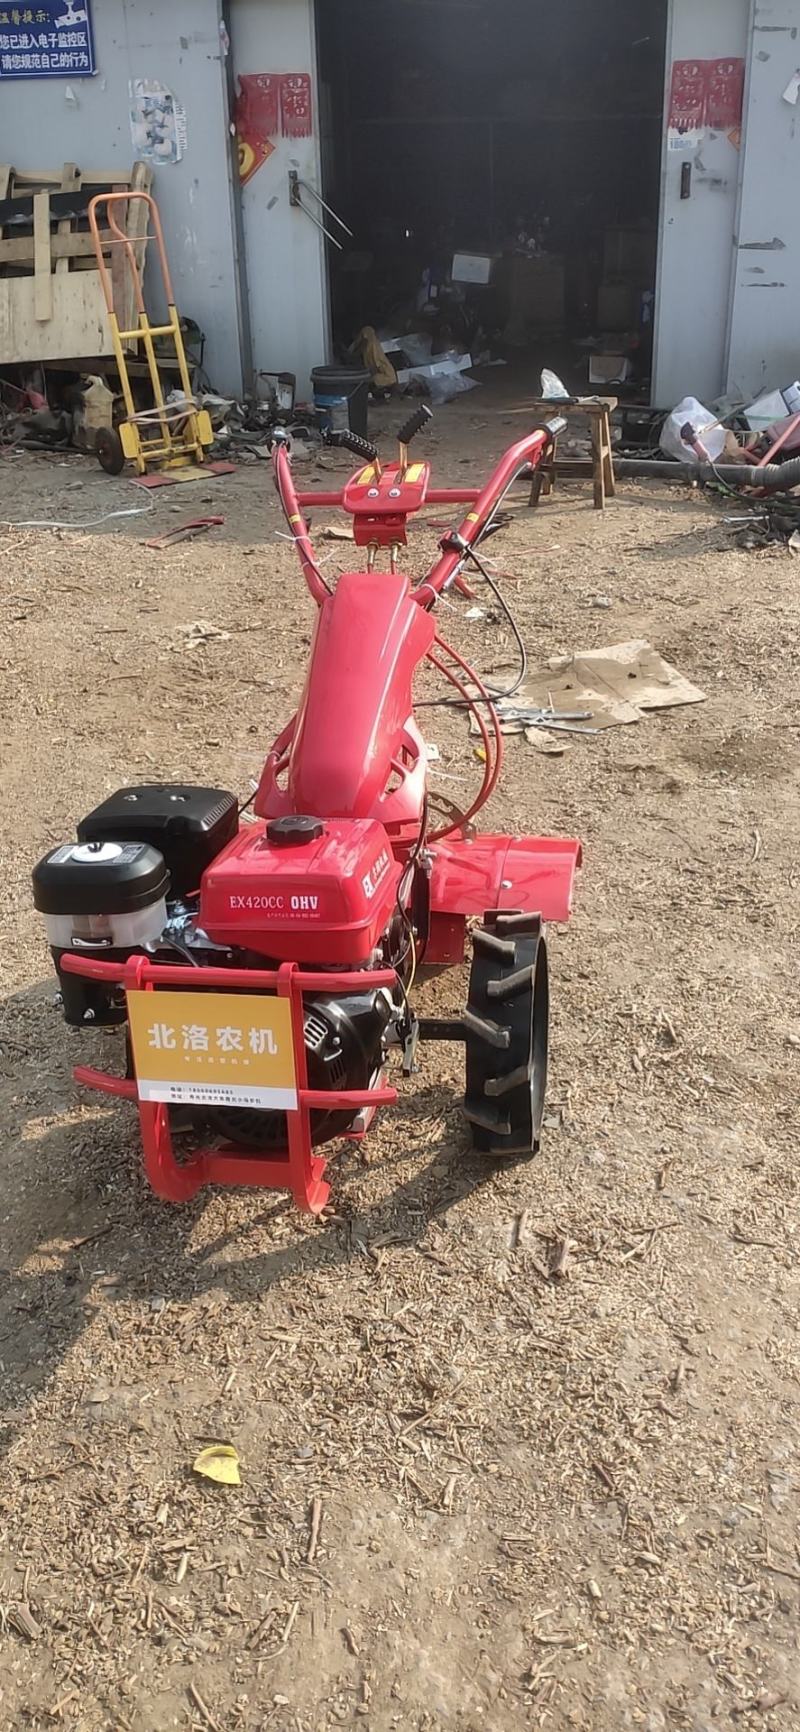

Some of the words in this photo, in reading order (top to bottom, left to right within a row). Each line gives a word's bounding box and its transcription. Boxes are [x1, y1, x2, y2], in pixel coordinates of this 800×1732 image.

[0, 32, 87, 50] 您已进入电子监控区
[1, 52, 89, 70] 请您规范自己的行为
[229, 895, 284, 909] EX420CC
[290, 895, 319, 910] OHV
[147, 1023, 278, 1055] 北洛农机
